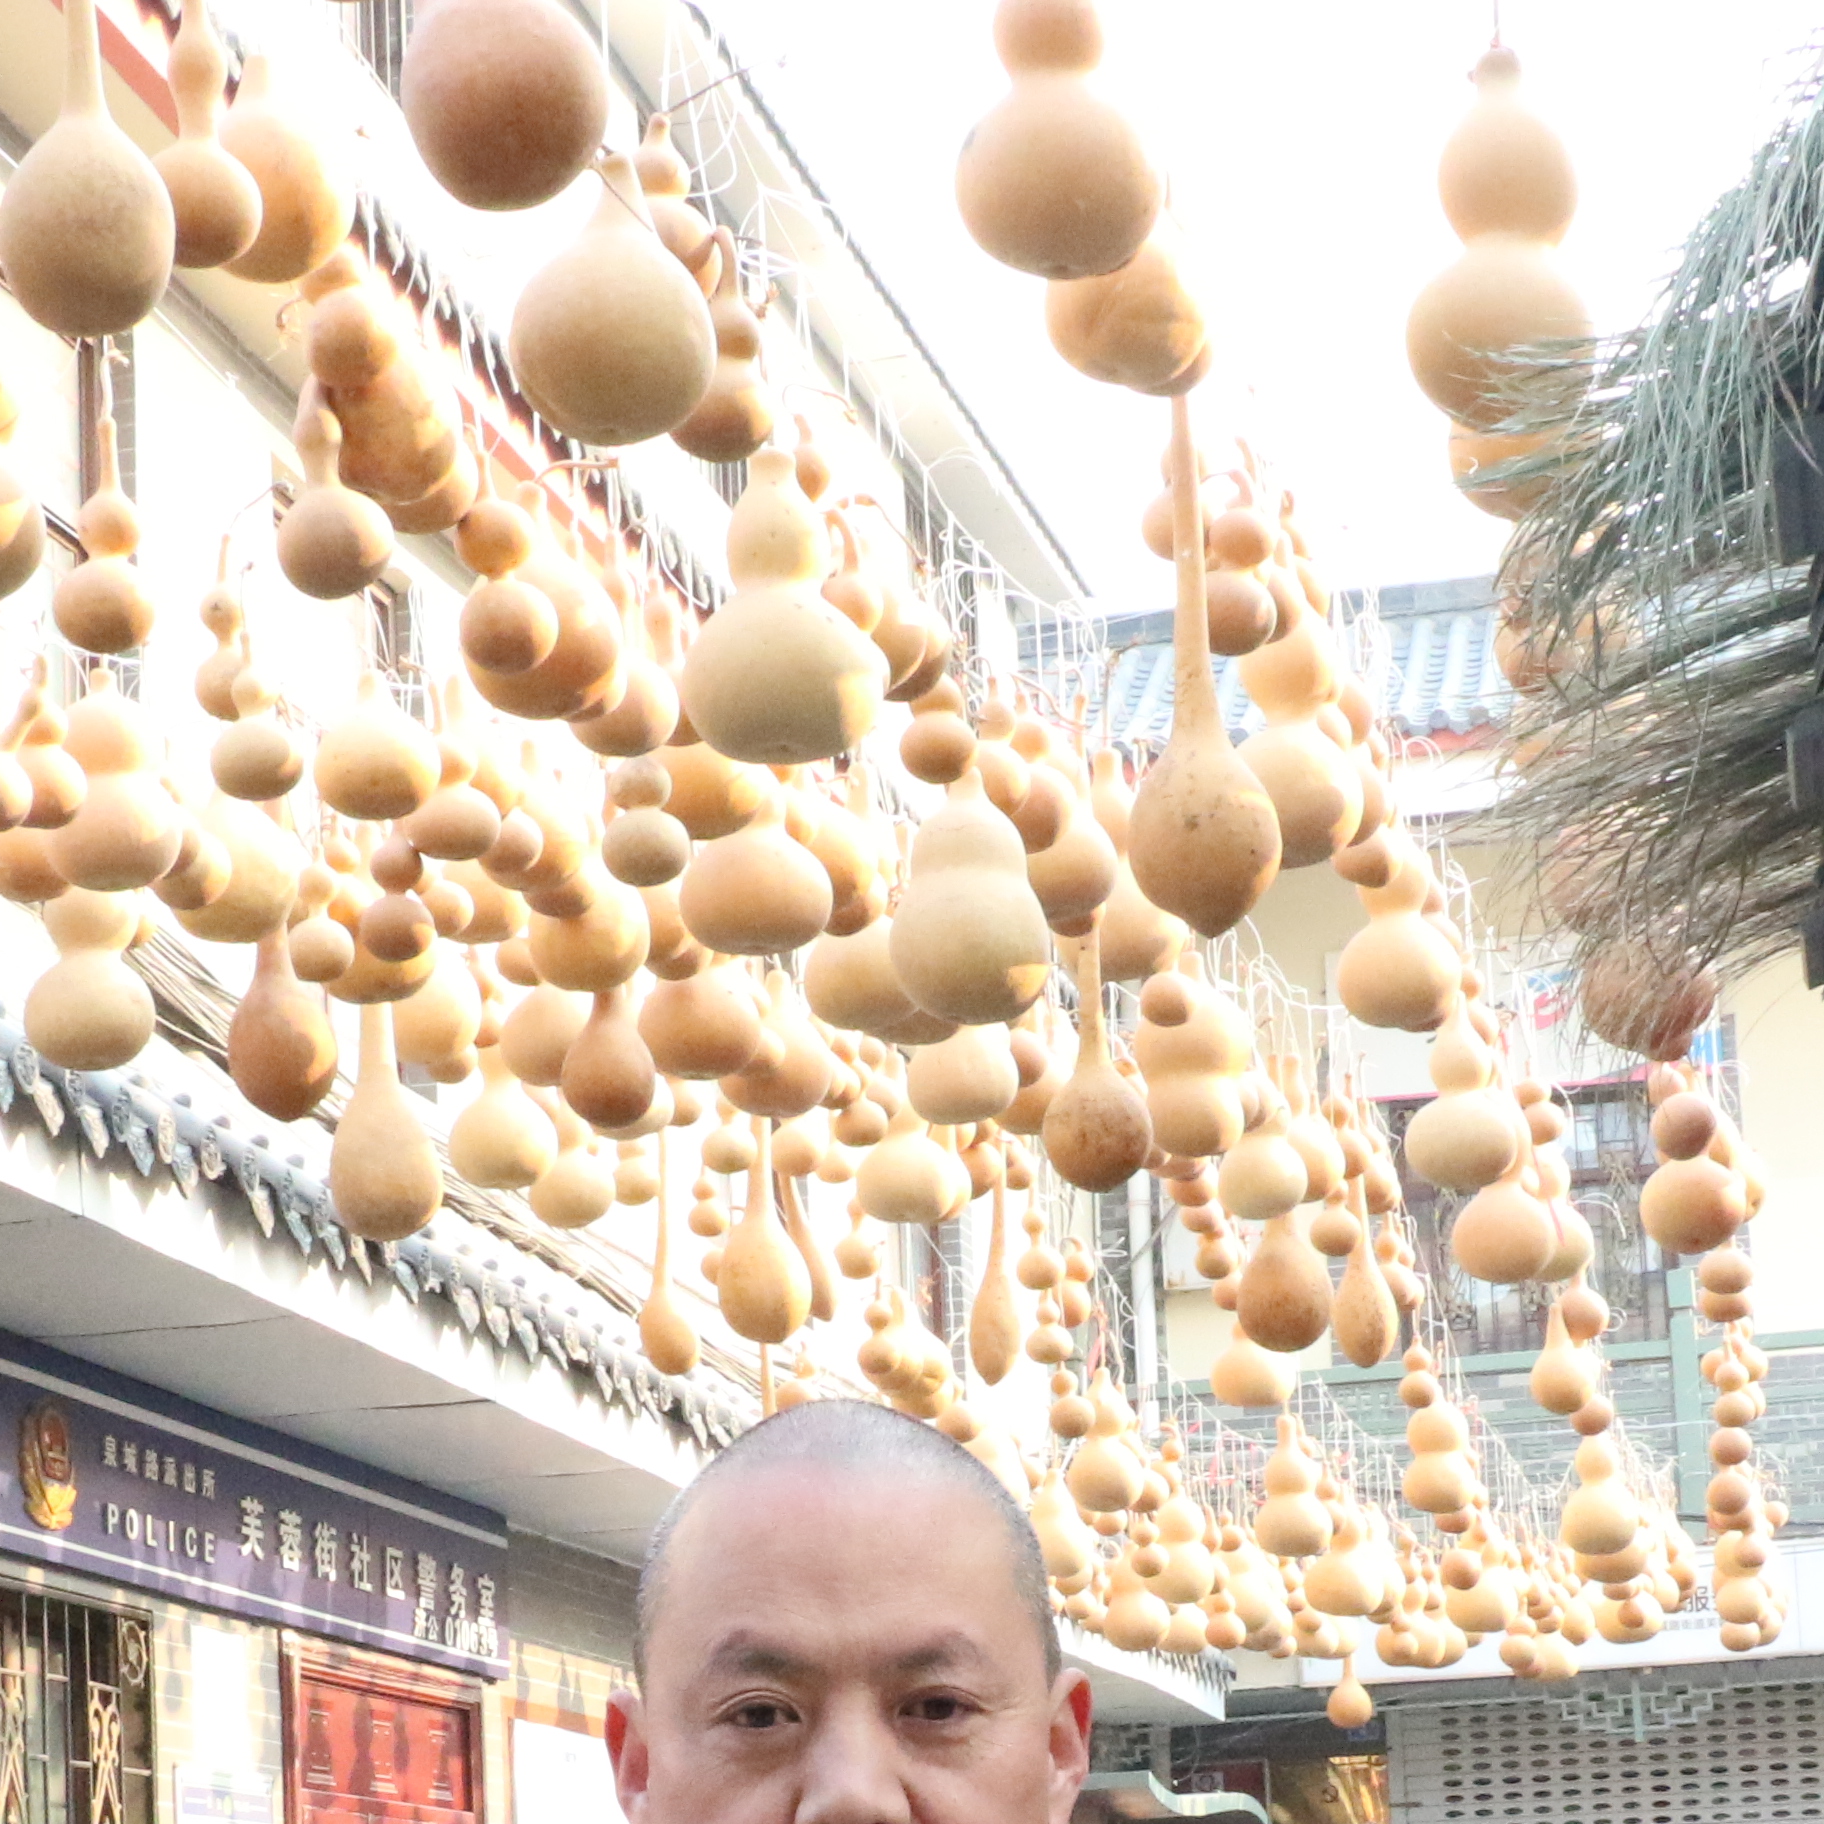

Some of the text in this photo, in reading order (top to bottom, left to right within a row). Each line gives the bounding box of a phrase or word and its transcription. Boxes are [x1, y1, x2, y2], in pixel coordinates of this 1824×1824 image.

[103, 1435, 215, 1499] 泉城路派出所
[107, 1503, 215, 1564] POLICE
[239, 1496, 495, 1627] 芙蓉街社区警务室
